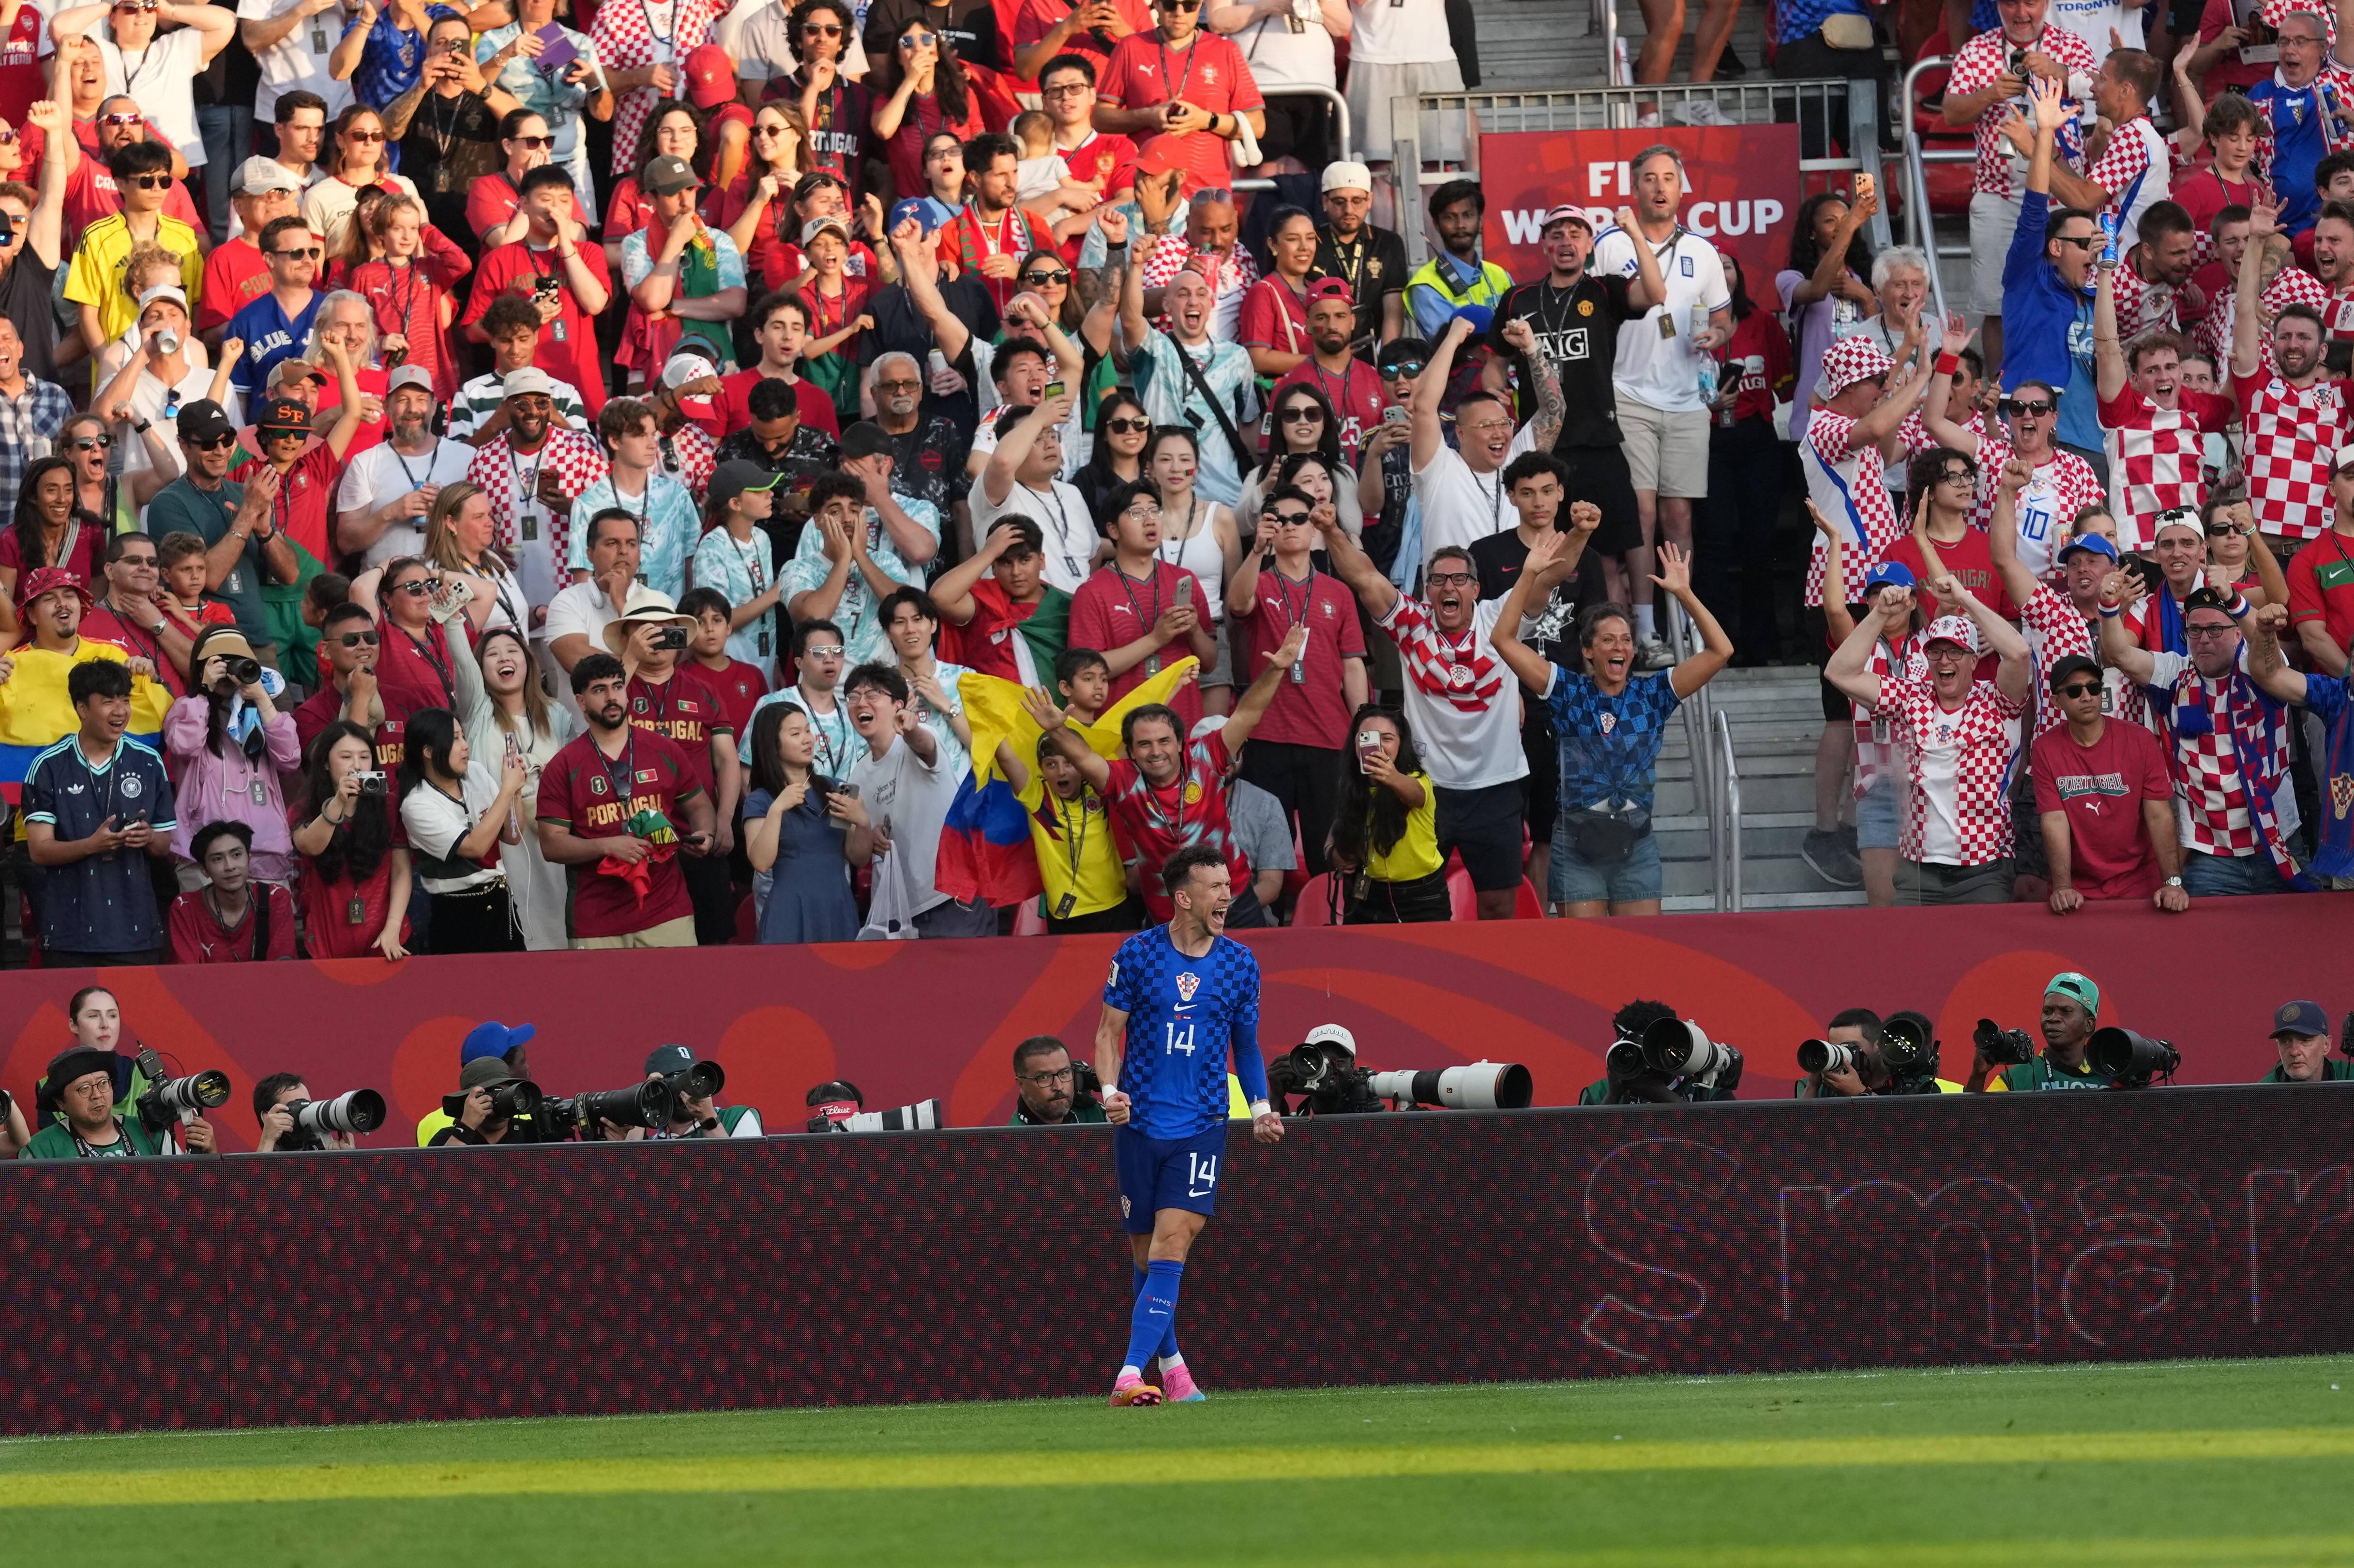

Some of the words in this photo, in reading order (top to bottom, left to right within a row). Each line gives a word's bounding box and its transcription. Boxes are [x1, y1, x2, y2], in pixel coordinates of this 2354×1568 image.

[1688, 199, 1784, 237] CUP
[249, 330, 292, 363] BLUE
[278, 406, 305, 423] SF
[2023, 507, 2049, 541] 10
[851, 612, 860, 639] 7
[2059, 773, 2129, 793] PORTUGAL
[1166, 1022, 1195, 1057] 14
[1313, 1028, 1329, 1038] NEW
[1329, 1029, 1347, 1040] YORK
[818, 1104, 850, 1117] Titleist
[75, 1138, 85, 1155] Canon
[1189, 1152, 1216, 1188] 14
[1153, 1297, 1171, 1307] HNS
